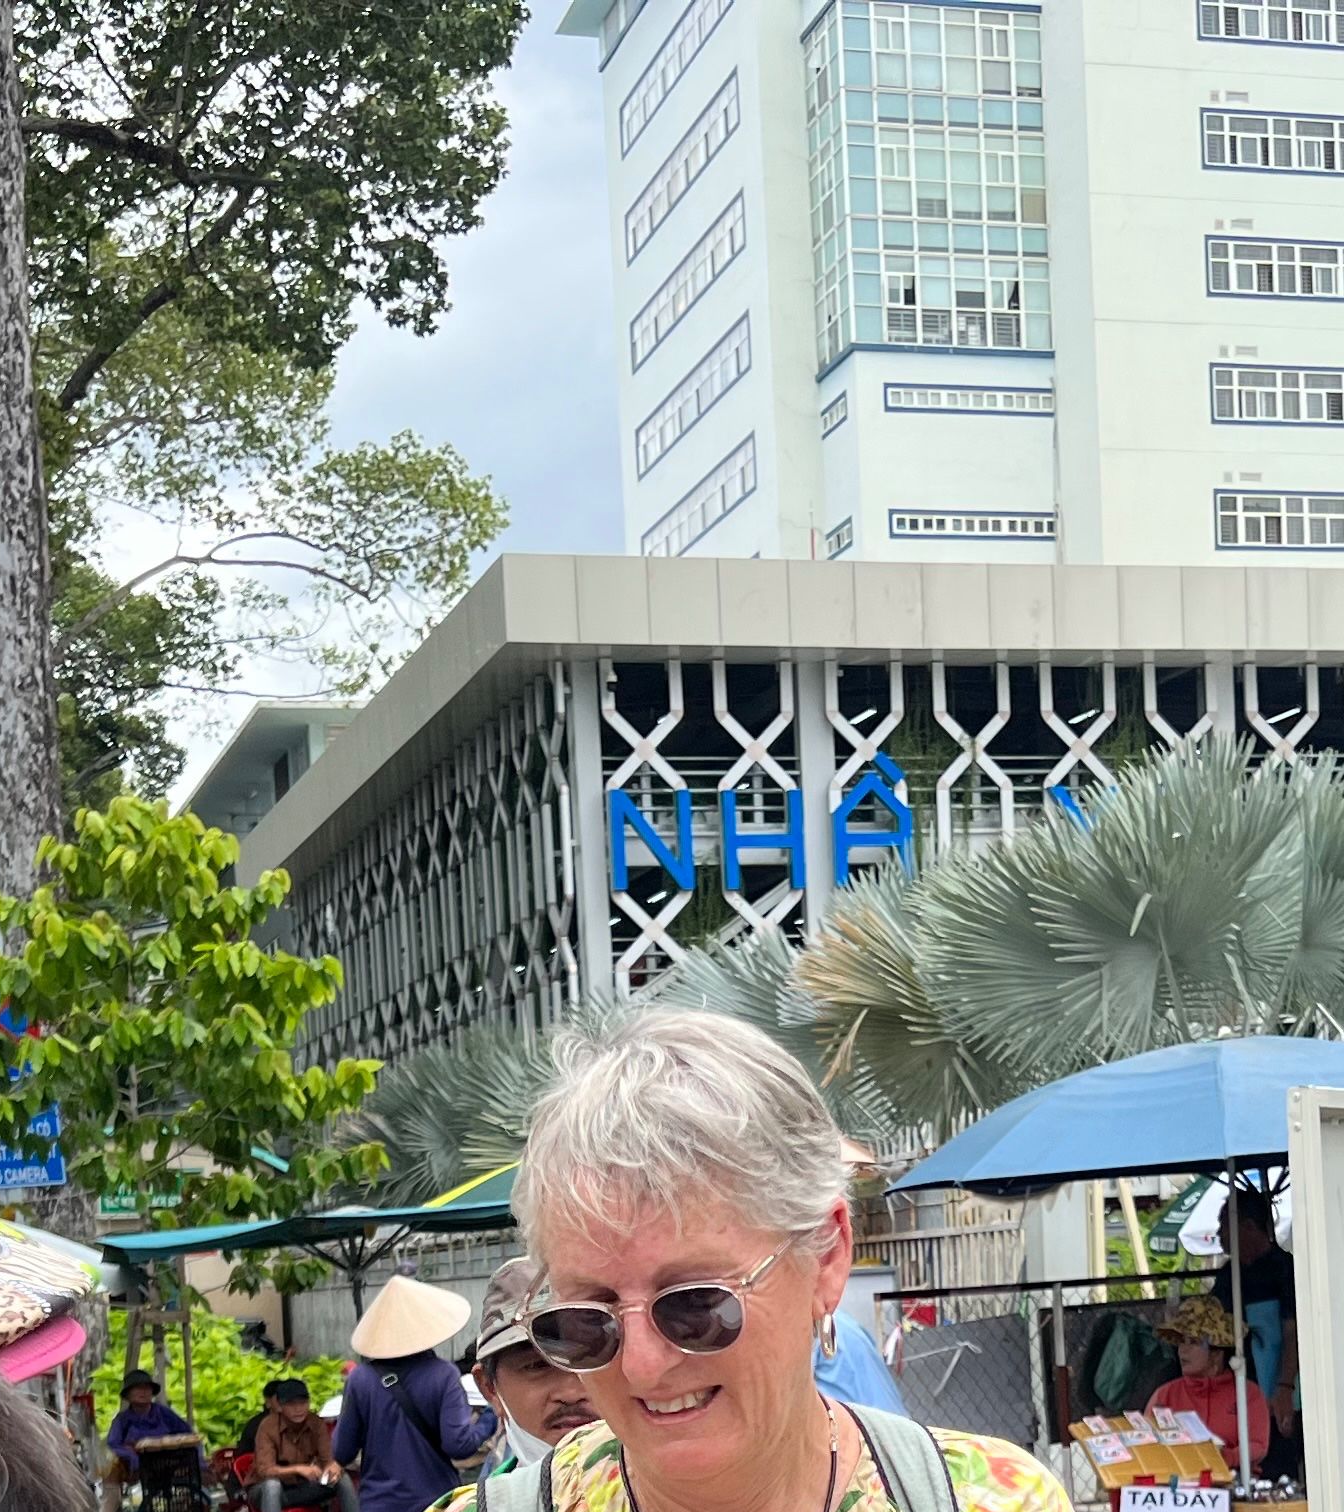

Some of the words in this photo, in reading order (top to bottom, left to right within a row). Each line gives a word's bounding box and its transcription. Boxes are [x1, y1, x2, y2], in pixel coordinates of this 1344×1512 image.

[610, 751, 913, 891] NHÀ
[4, 1166, 49, 1182] CAMERA
[1128, 1490, 1165, 1511] TẠI
